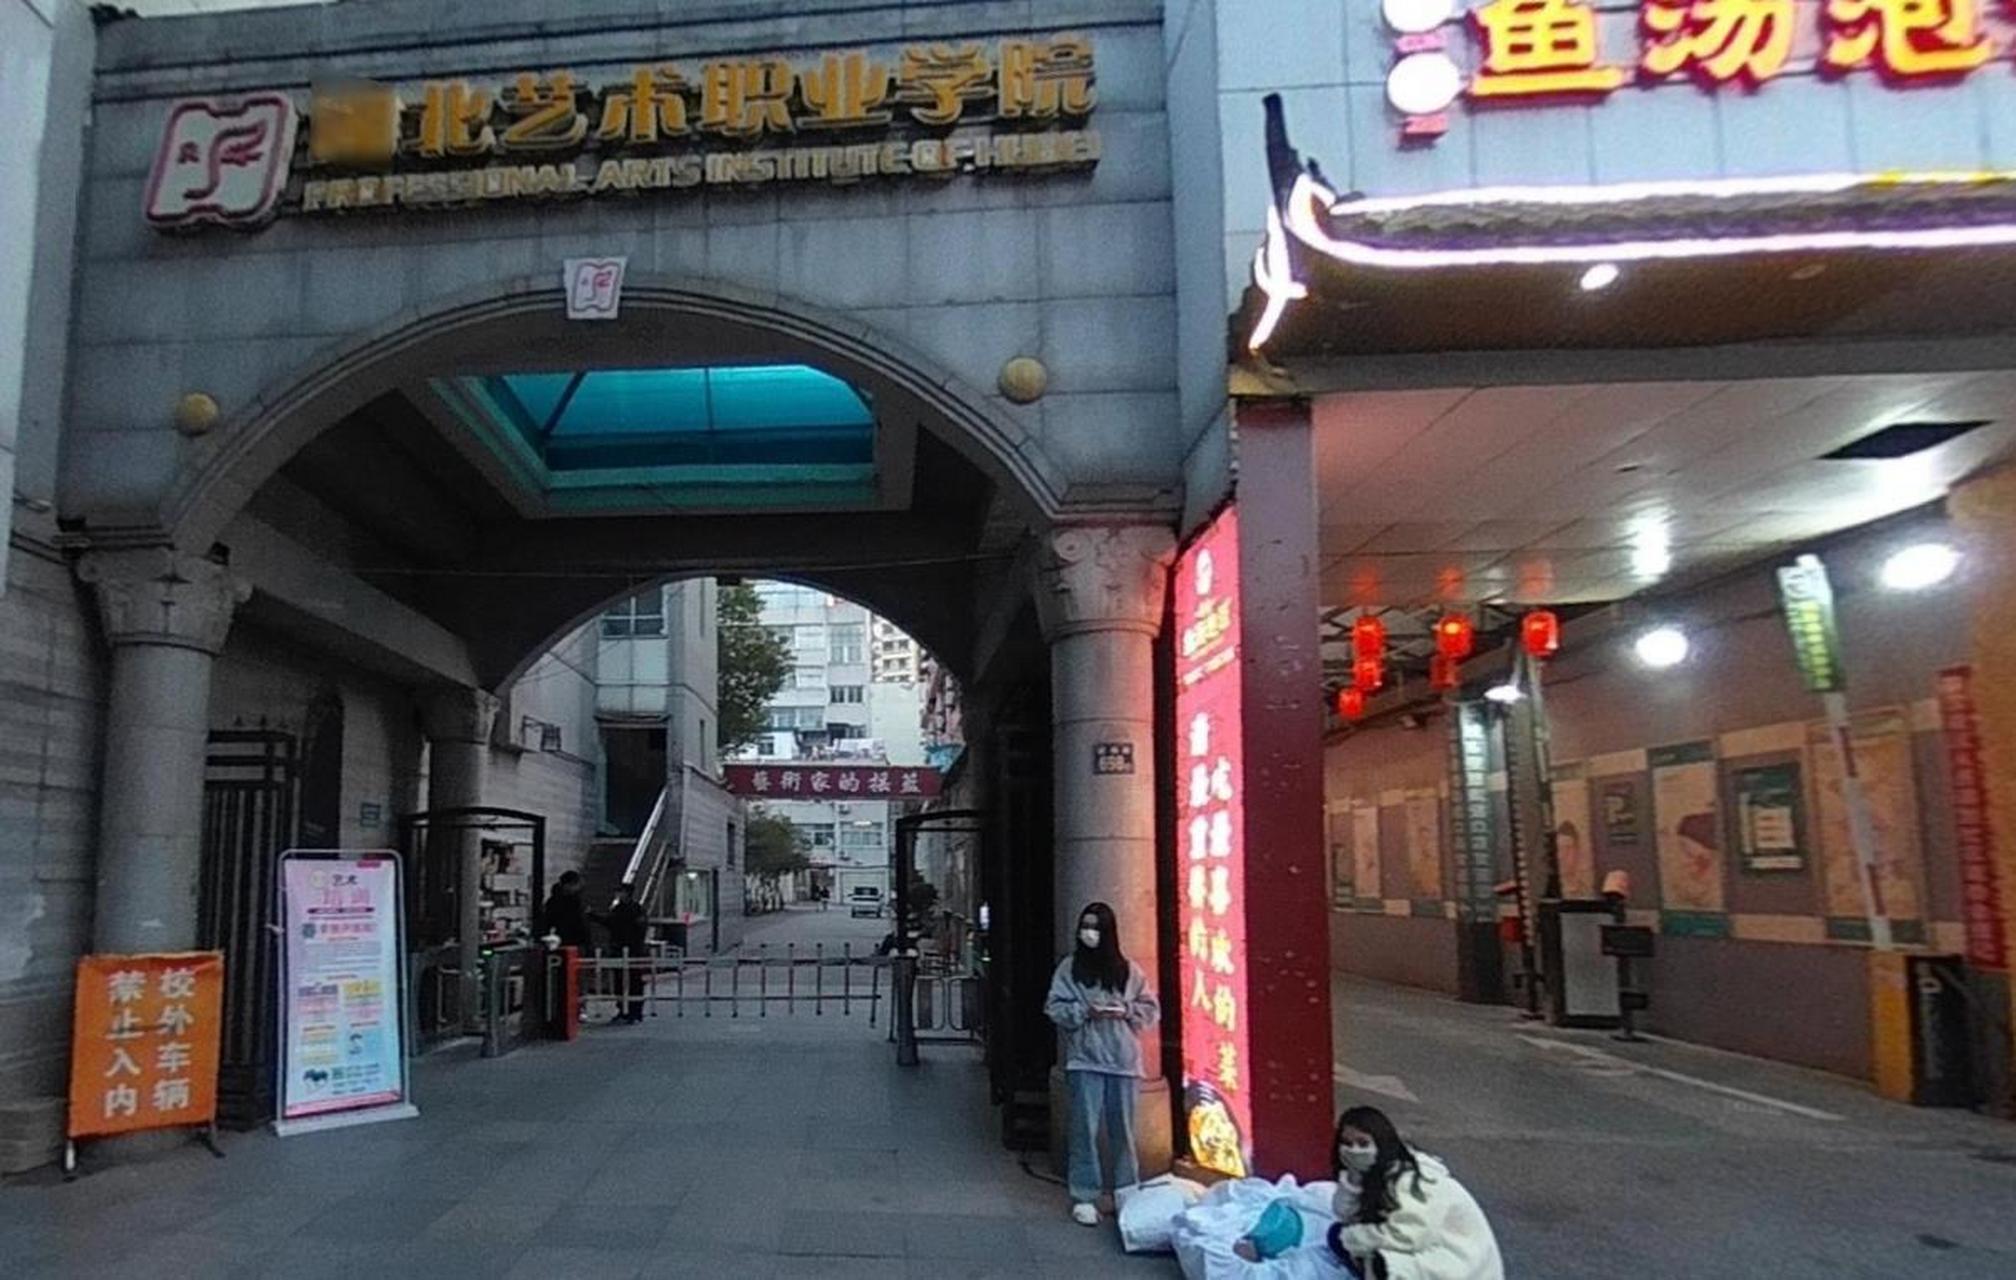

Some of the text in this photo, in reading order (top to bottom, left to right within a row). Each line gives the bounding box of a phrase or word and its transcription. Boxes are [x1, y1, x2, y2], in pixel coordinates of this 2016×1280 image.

[311, 35, 1098, 162] 北艺术职业学院
[594, 154, 702, 192] ARTS
[704, 142, 911, 186] INSTITUTE
[104, 969, 147, 1118] 禁止入内
[152, 966, 197, 1111] 校外车辆
